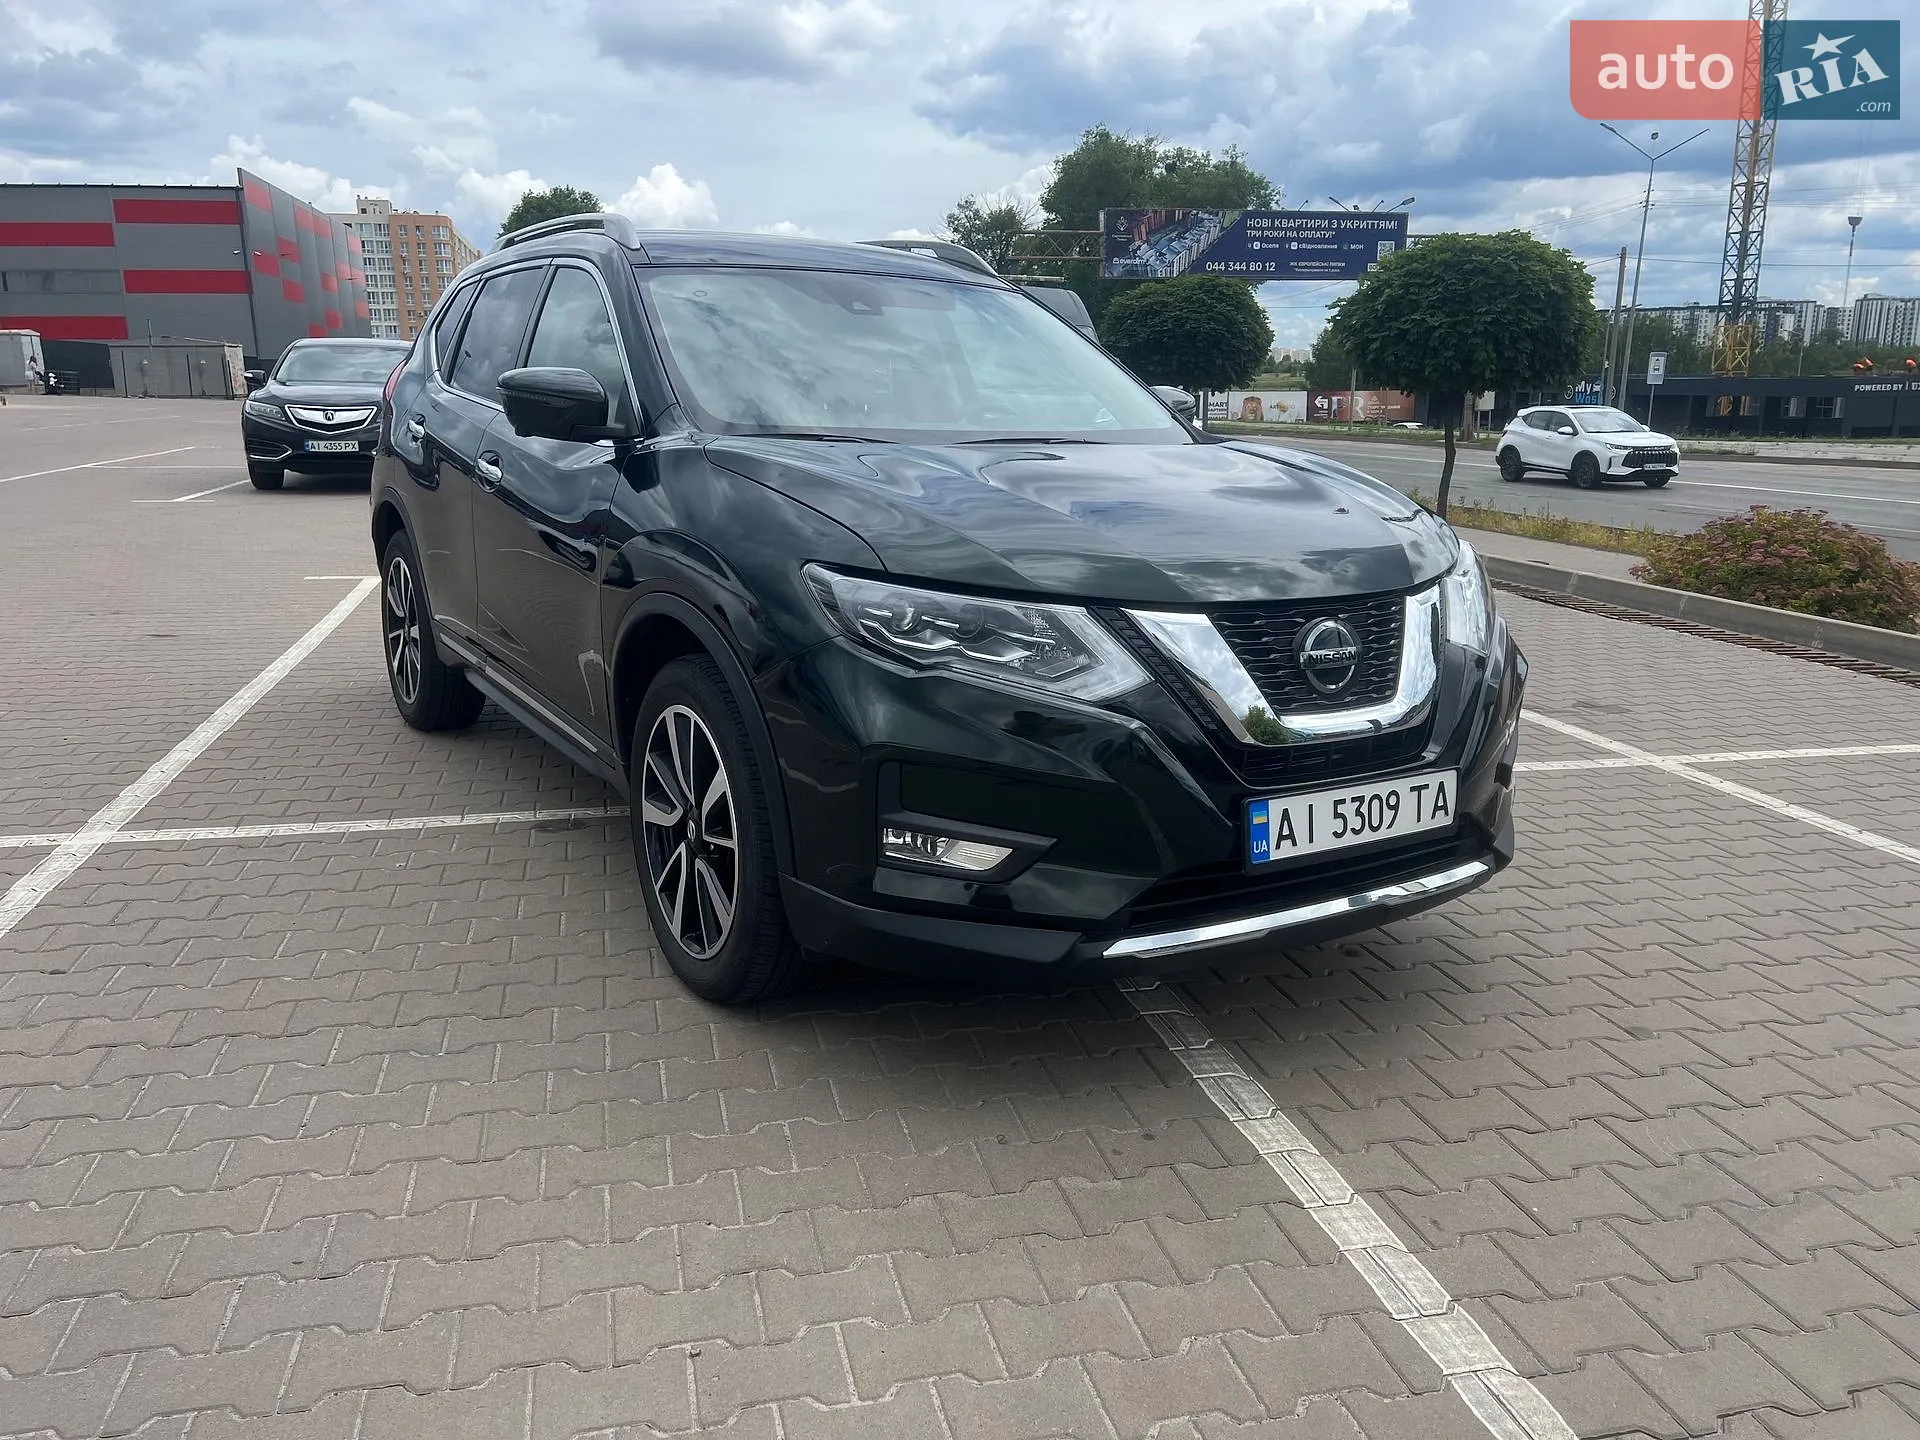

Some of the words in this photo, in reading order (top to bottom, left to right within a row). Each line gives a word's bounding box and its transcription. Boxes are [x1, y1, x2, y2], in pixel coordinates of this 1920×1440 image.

[1247, 218, 1271, 227] НОВІ
[1274, 218, 1328, 228] КВАРТИРИ
[1340, 220, 1398, 230] УКРИТТЯМ!
[1246, 230, 1262, 238] ТРИ
[1263, 230, 1285, 238] РОКИ
[1206, 262, 1225, 271] 044
[1228, 262, 1247, 271] 344
[1249, 262, 1262, 271] 80
[1265, 262, 1276, 271] 12
[1854, 384, 1892, 392] POWERED
[311, 442, 320, 450] AI
[324, 442, 343, 450] 4355
[344, 442, 357, 450] PX
[1308, 650, 1356, 664] NISSAN
[1275, 803, 1314, 850] AI
[1332, 790, 1401, 839] 5309
[1409, 781, 1449, 824] TA
[1253, 840, 1268, 853] UA
